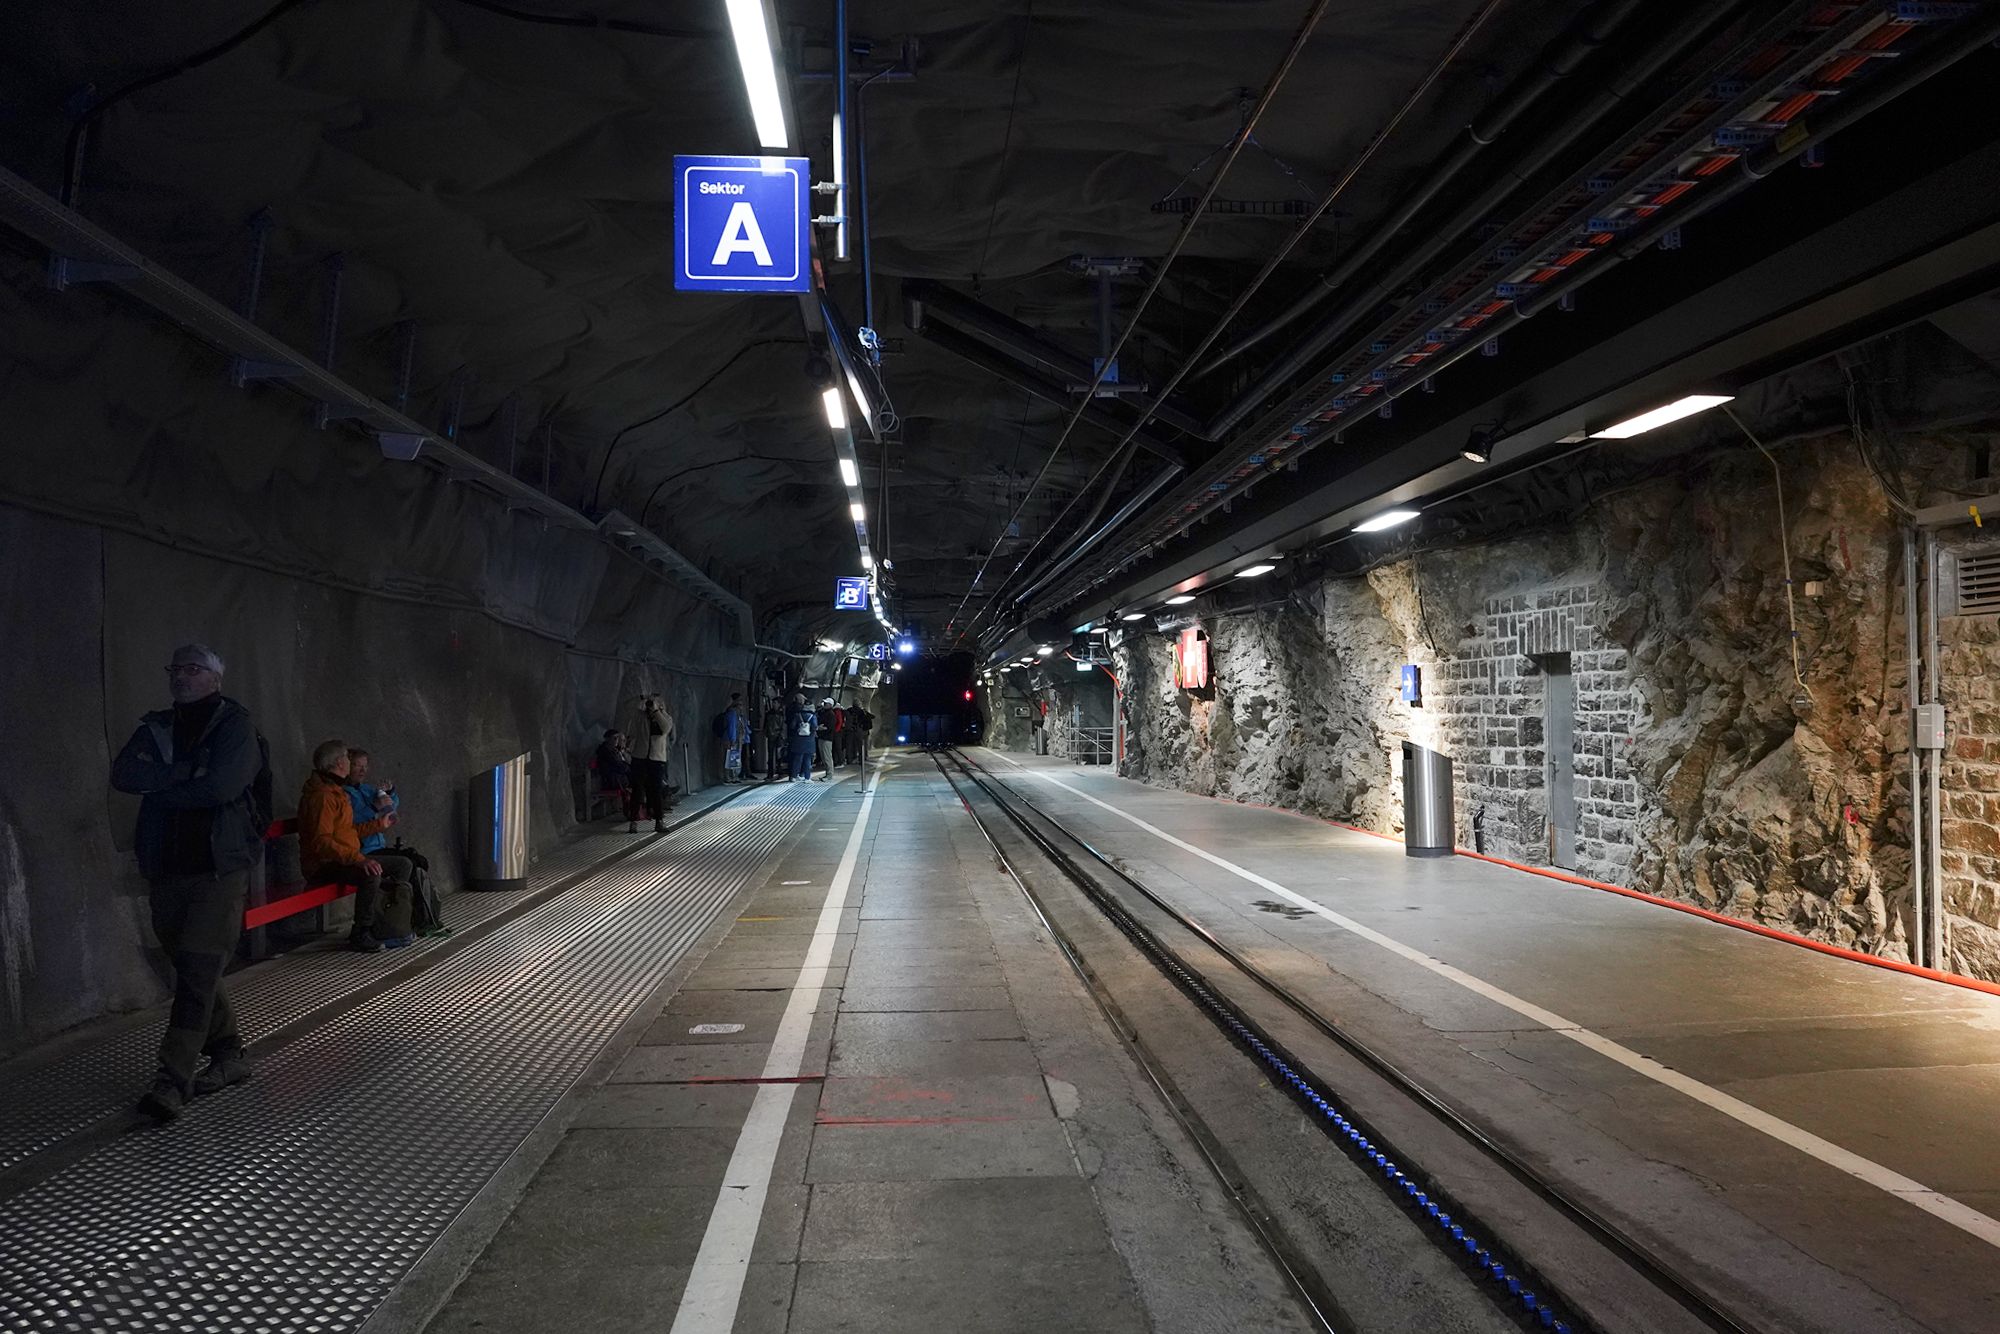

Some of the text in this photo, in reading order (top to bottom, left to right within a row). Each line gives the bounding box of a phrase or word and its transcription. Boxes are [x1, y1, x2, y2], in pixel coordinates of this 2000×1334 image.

[699, 181, 745, 195] Sektor
[711, 201, 773, 266] A
[844, 587, 859, 604] B
